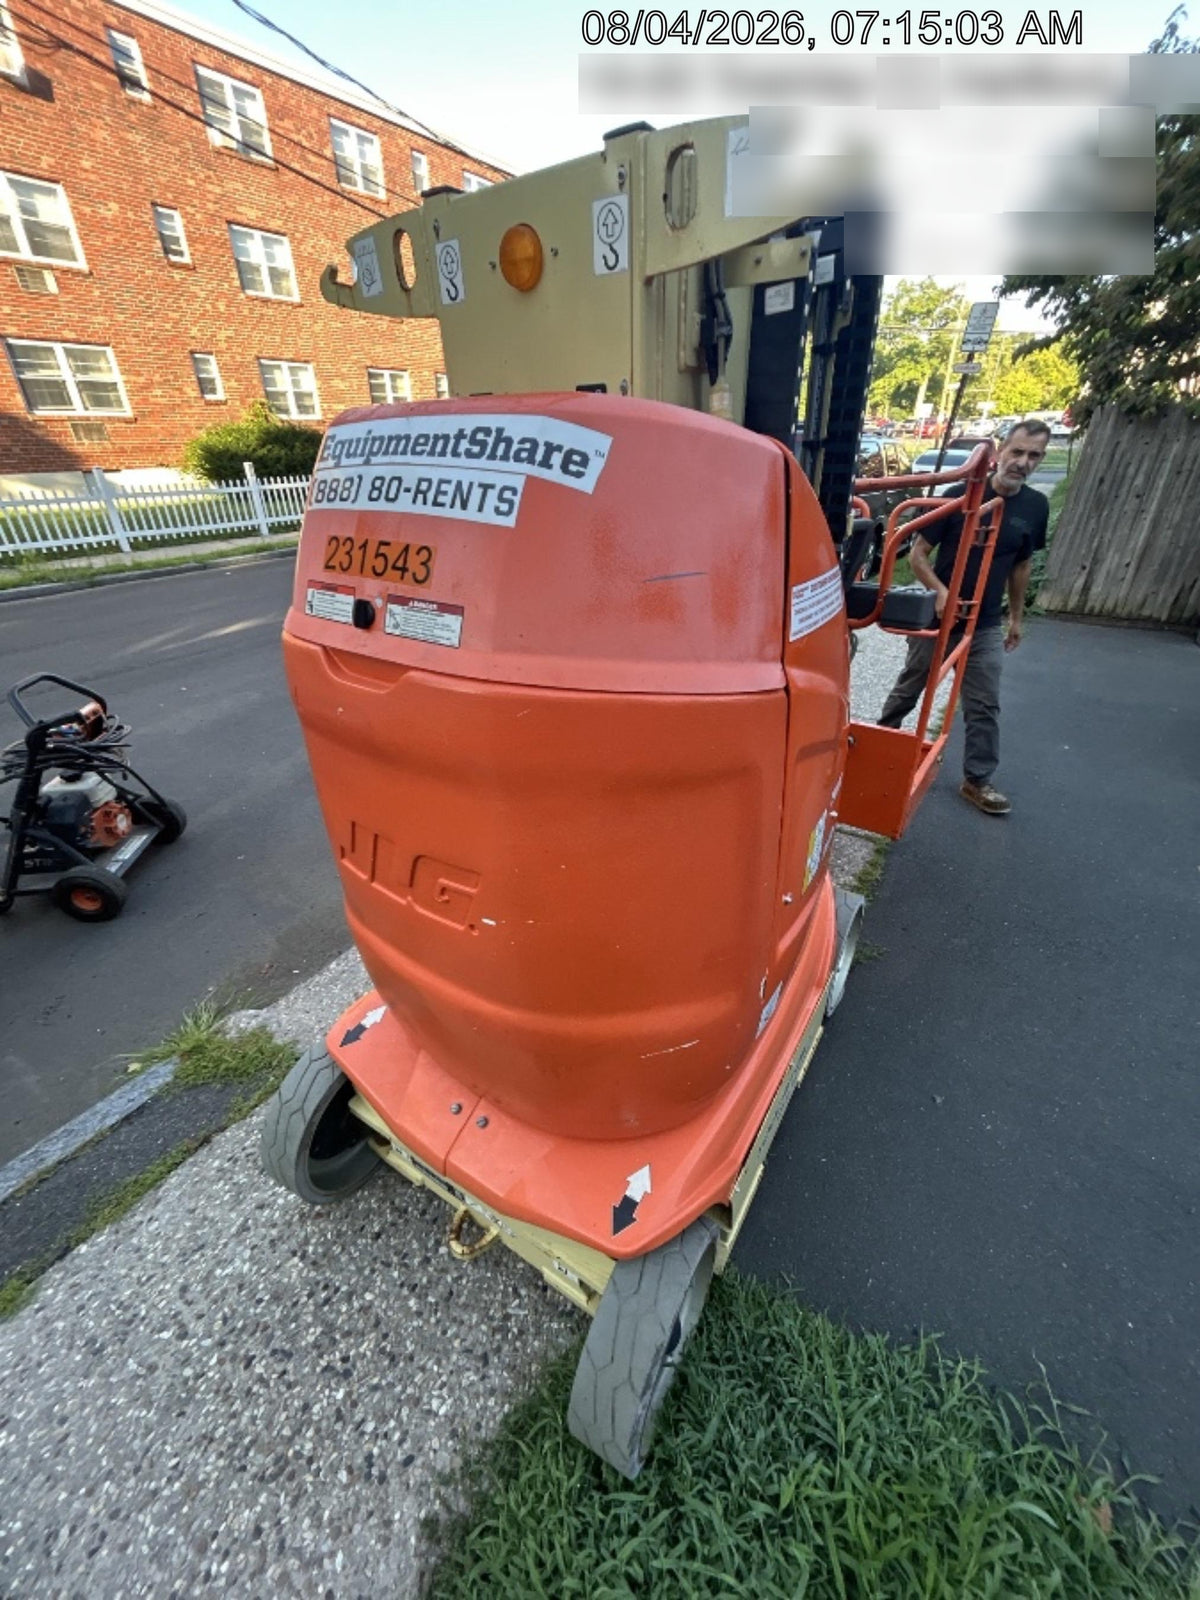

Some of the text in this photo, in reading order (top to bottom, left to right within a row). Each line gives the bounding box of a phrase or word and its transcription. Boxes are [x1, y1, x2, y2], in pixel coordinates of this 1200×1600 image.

[309, 474, 518, 517] (888) 80-RENTS
[324, 536, 432, 584] 231543
[339, 820, 481, 931] JLG
